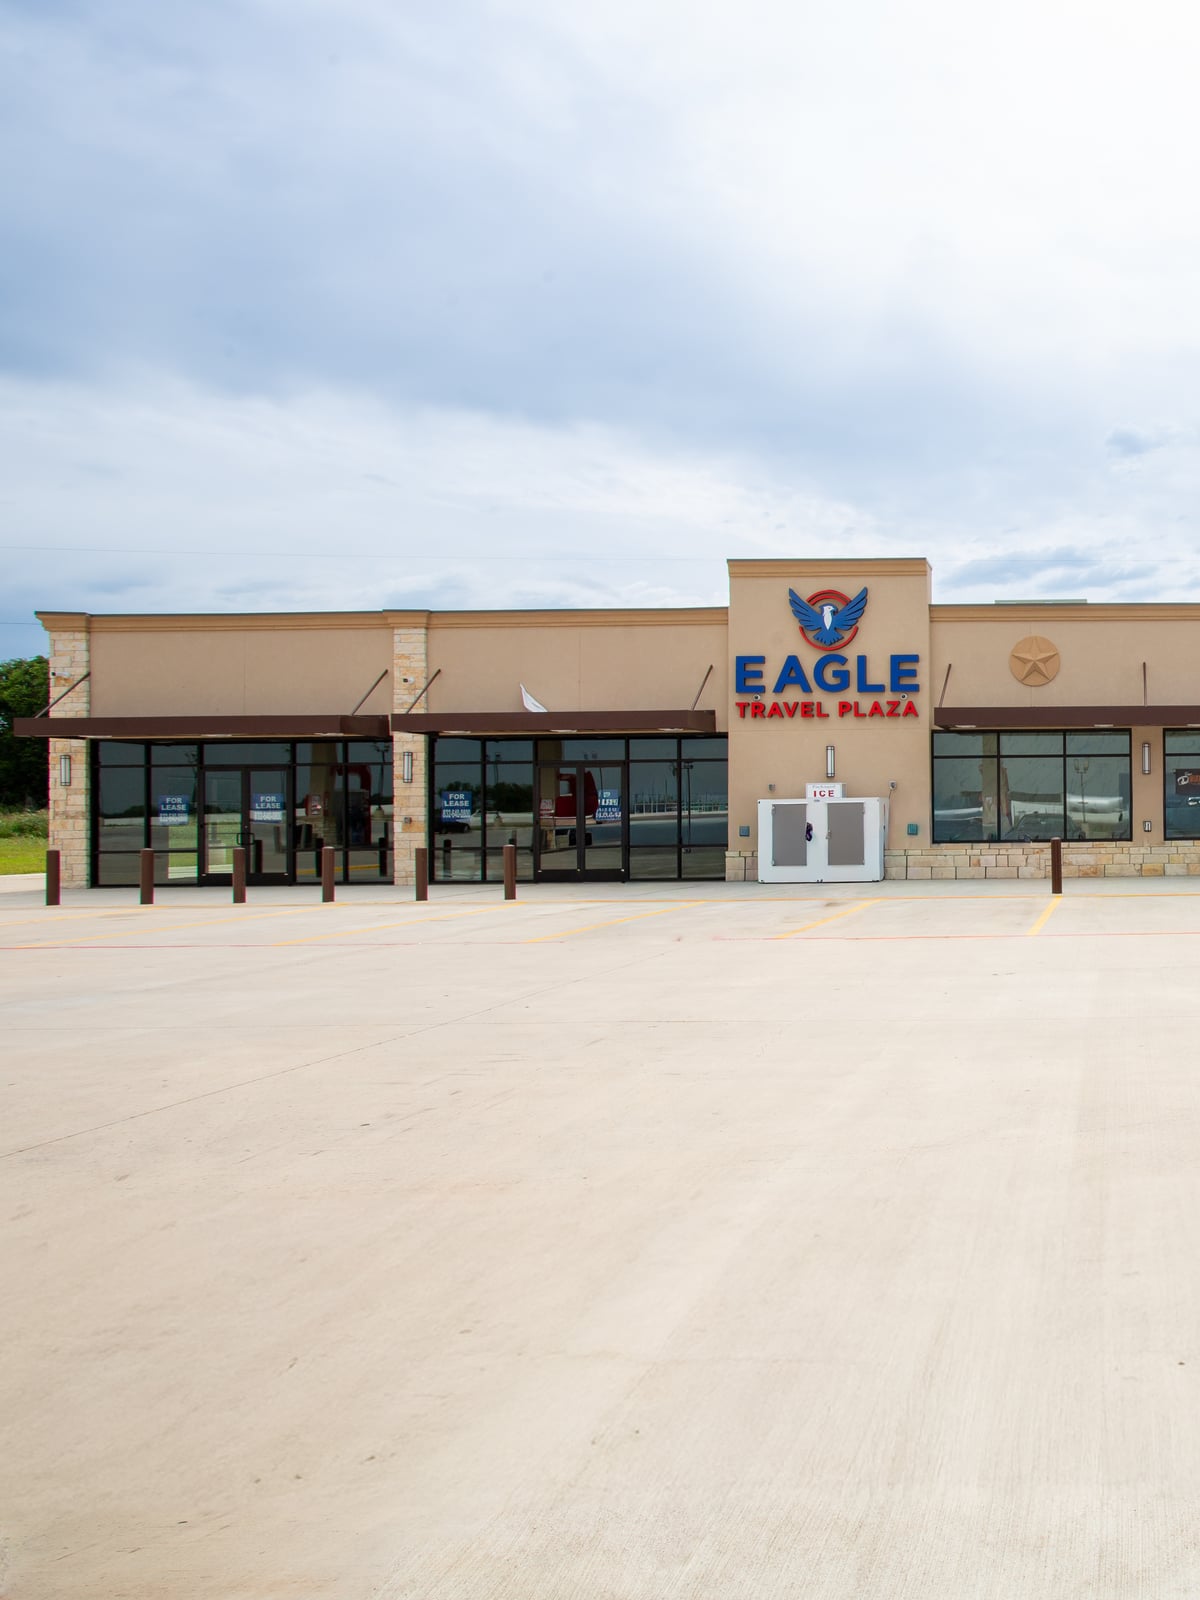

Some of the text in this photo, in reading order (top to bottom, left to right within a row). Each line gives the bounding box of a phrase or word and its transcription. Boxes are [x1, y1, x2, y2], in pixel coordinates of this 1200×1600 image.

[735, 653, 920, 694] EAGLE
[735, 701, 919, 718] TRAVEL PLAZA
